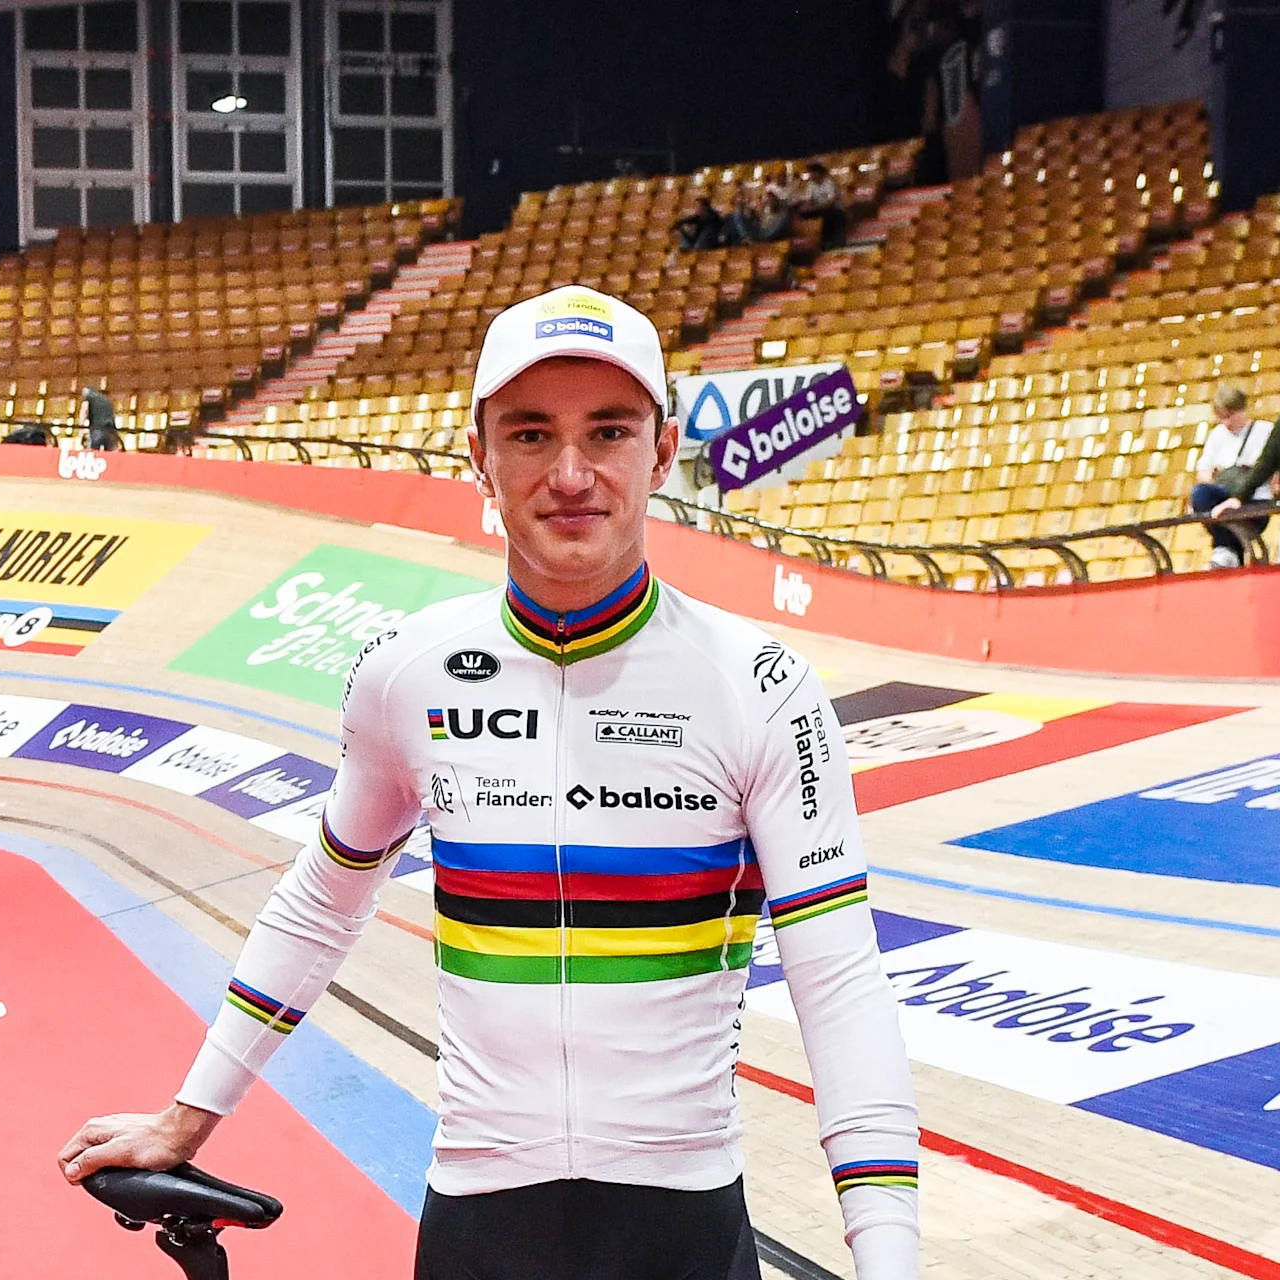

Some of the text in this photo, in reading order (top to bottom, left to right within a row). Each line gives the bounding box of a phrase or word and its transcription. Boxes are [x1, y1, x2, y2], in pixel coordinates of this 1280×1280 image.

[556, 320, 609, 337] baloise
[748, 386, 853, 464] baloise
[58, 446, 107, 481] lotto
[452, 668, 492, 677] vermarc
[70, 720, 150, 758] baloise
[447, 708, 539, 740] UCI
[618, 726, 679, 740] CALLANT
[810, 702, 831, 763] Team
[474, 776, 517, 788] Team
[790, 714, 820, 821] Flanders
[599, 785, 718, 811] baloise
[897, 969, 1196, 1053] baloise
